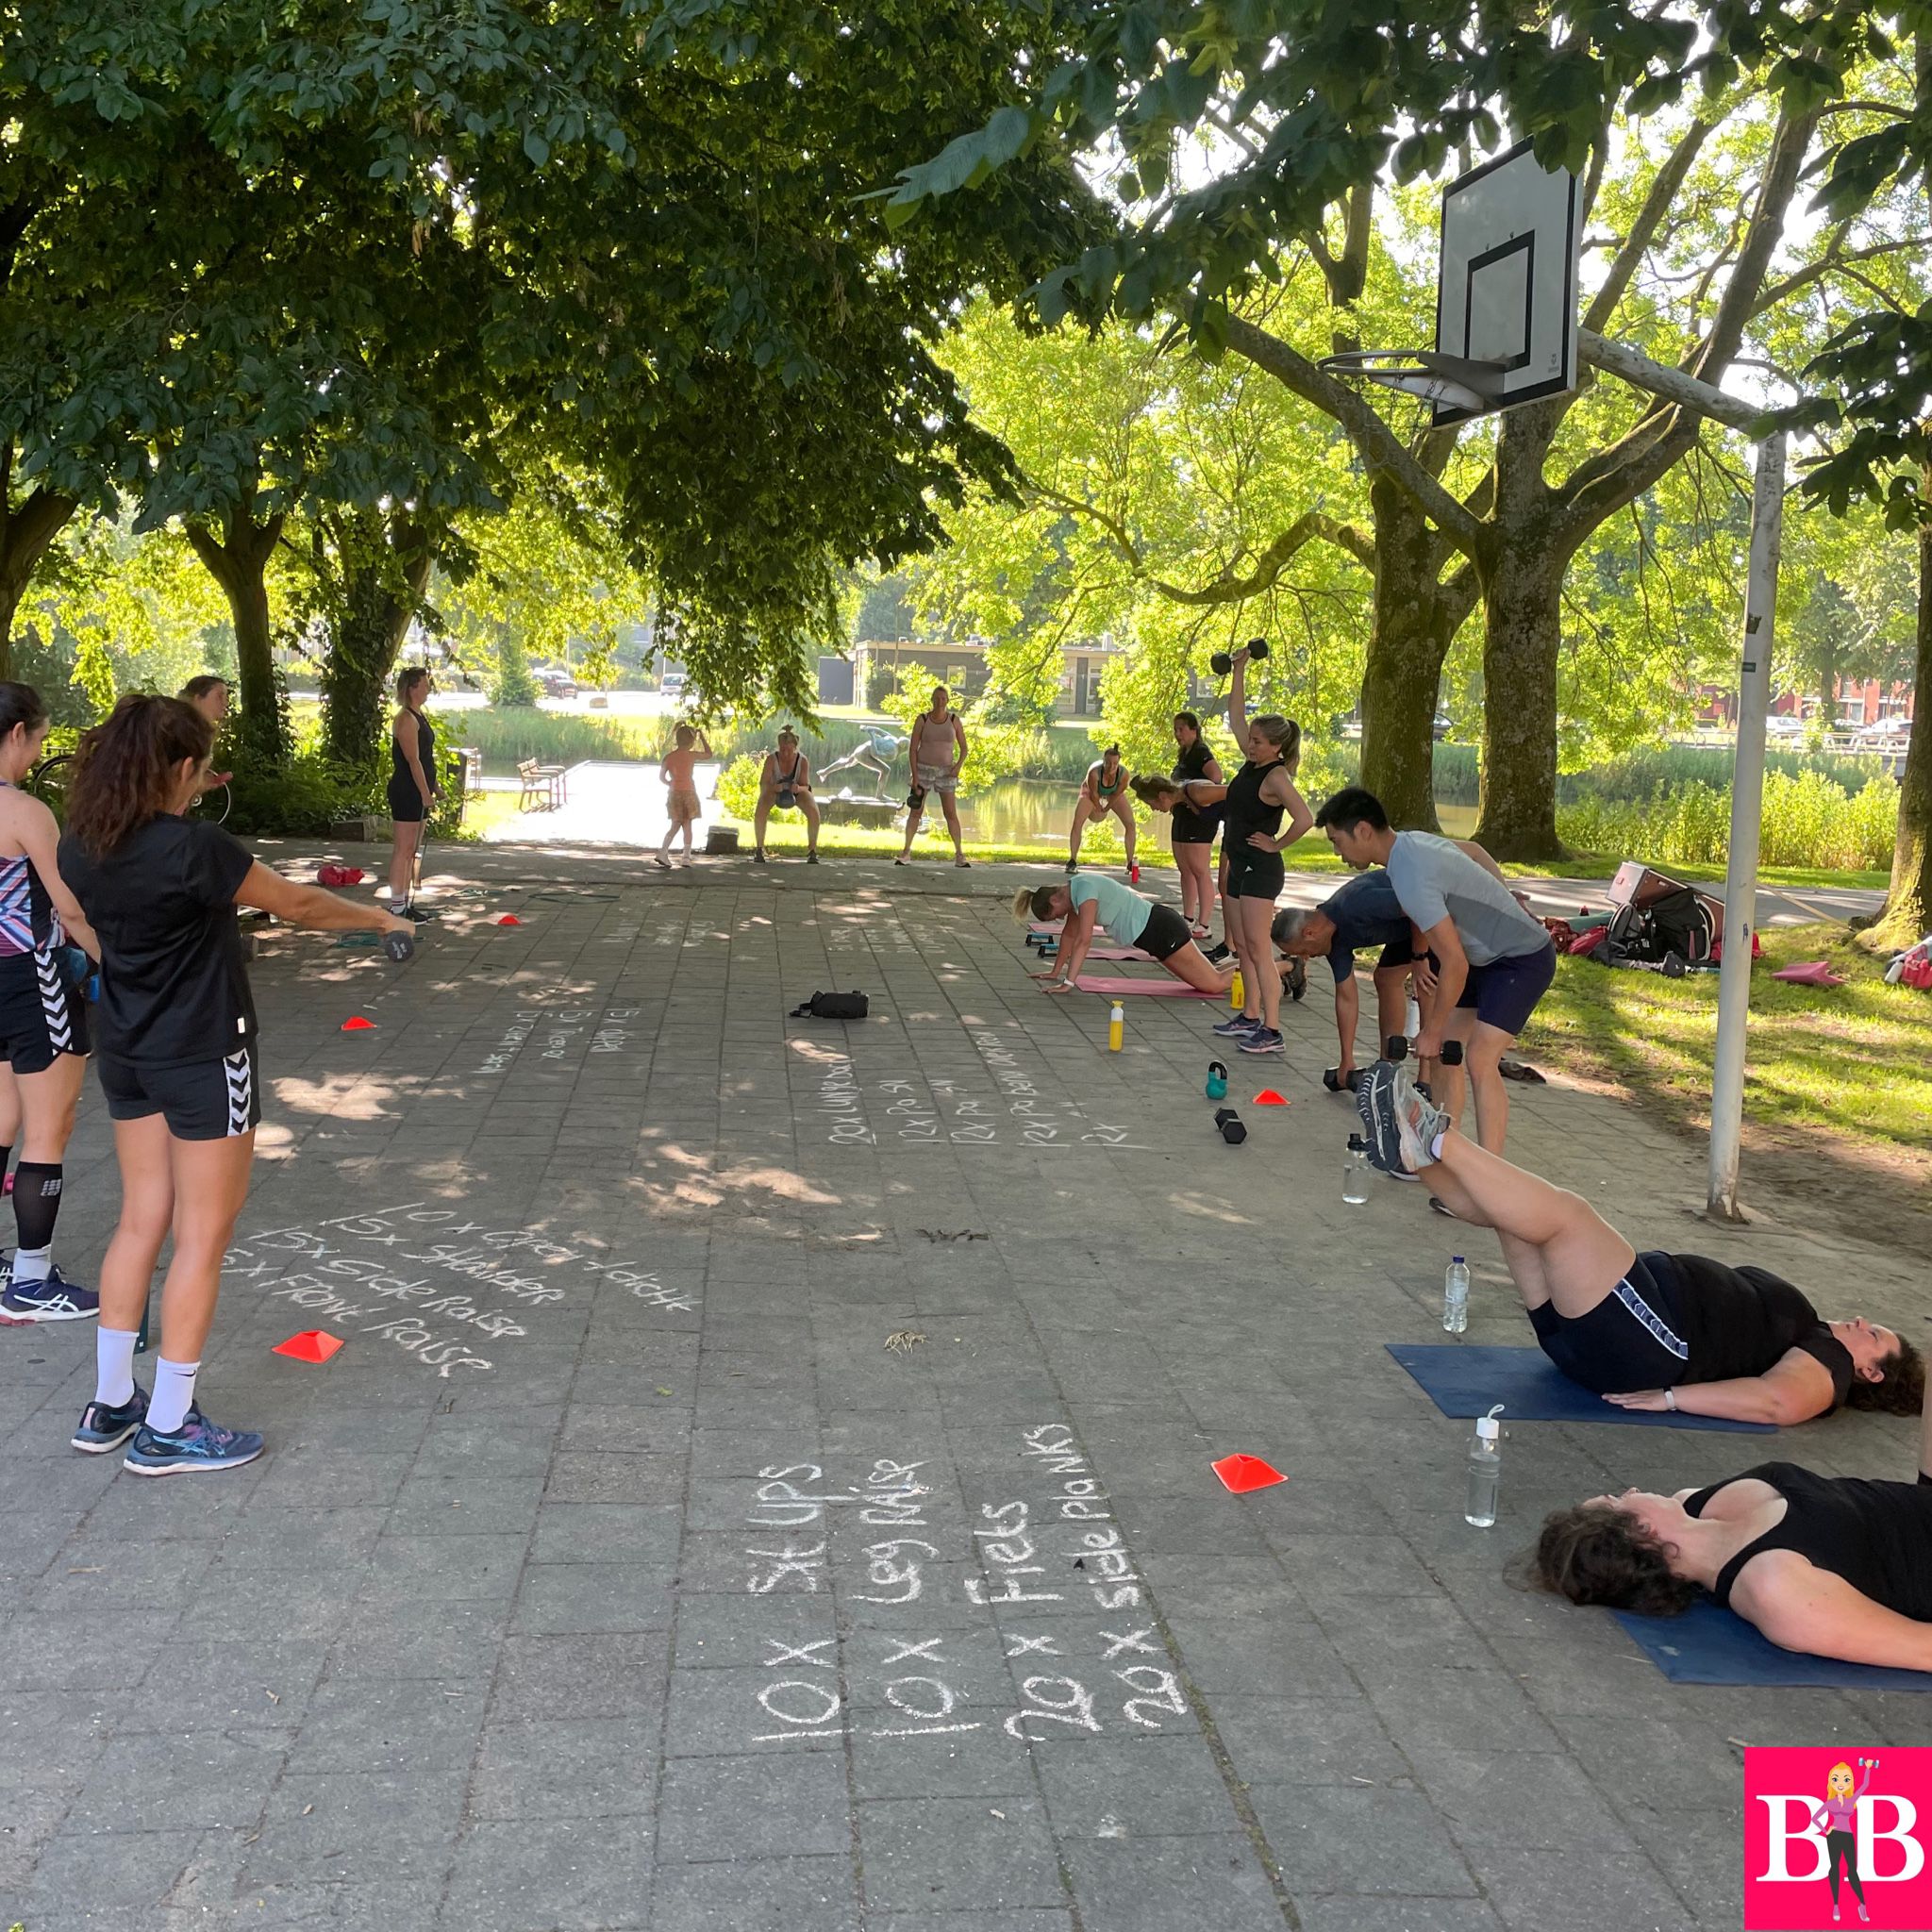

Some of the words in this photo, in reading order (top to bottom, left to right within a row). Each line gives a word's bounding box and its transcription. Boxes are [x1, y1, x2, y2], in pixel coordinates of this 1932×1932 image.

[828, 1116, 876, 1145] 20x
[898, 1119, 948, 1144] 12x
[950, 1121, 1002, 1145] 12x
[1016, 1119, 1072, 1147] 12x
[751, 1638, 857, 1740] 10x
[871, 1638, 983, 1737] 10x
[1004, 1633, 1103, 1742] 20x
[1098, 1628, 1188, 1729] 20x
